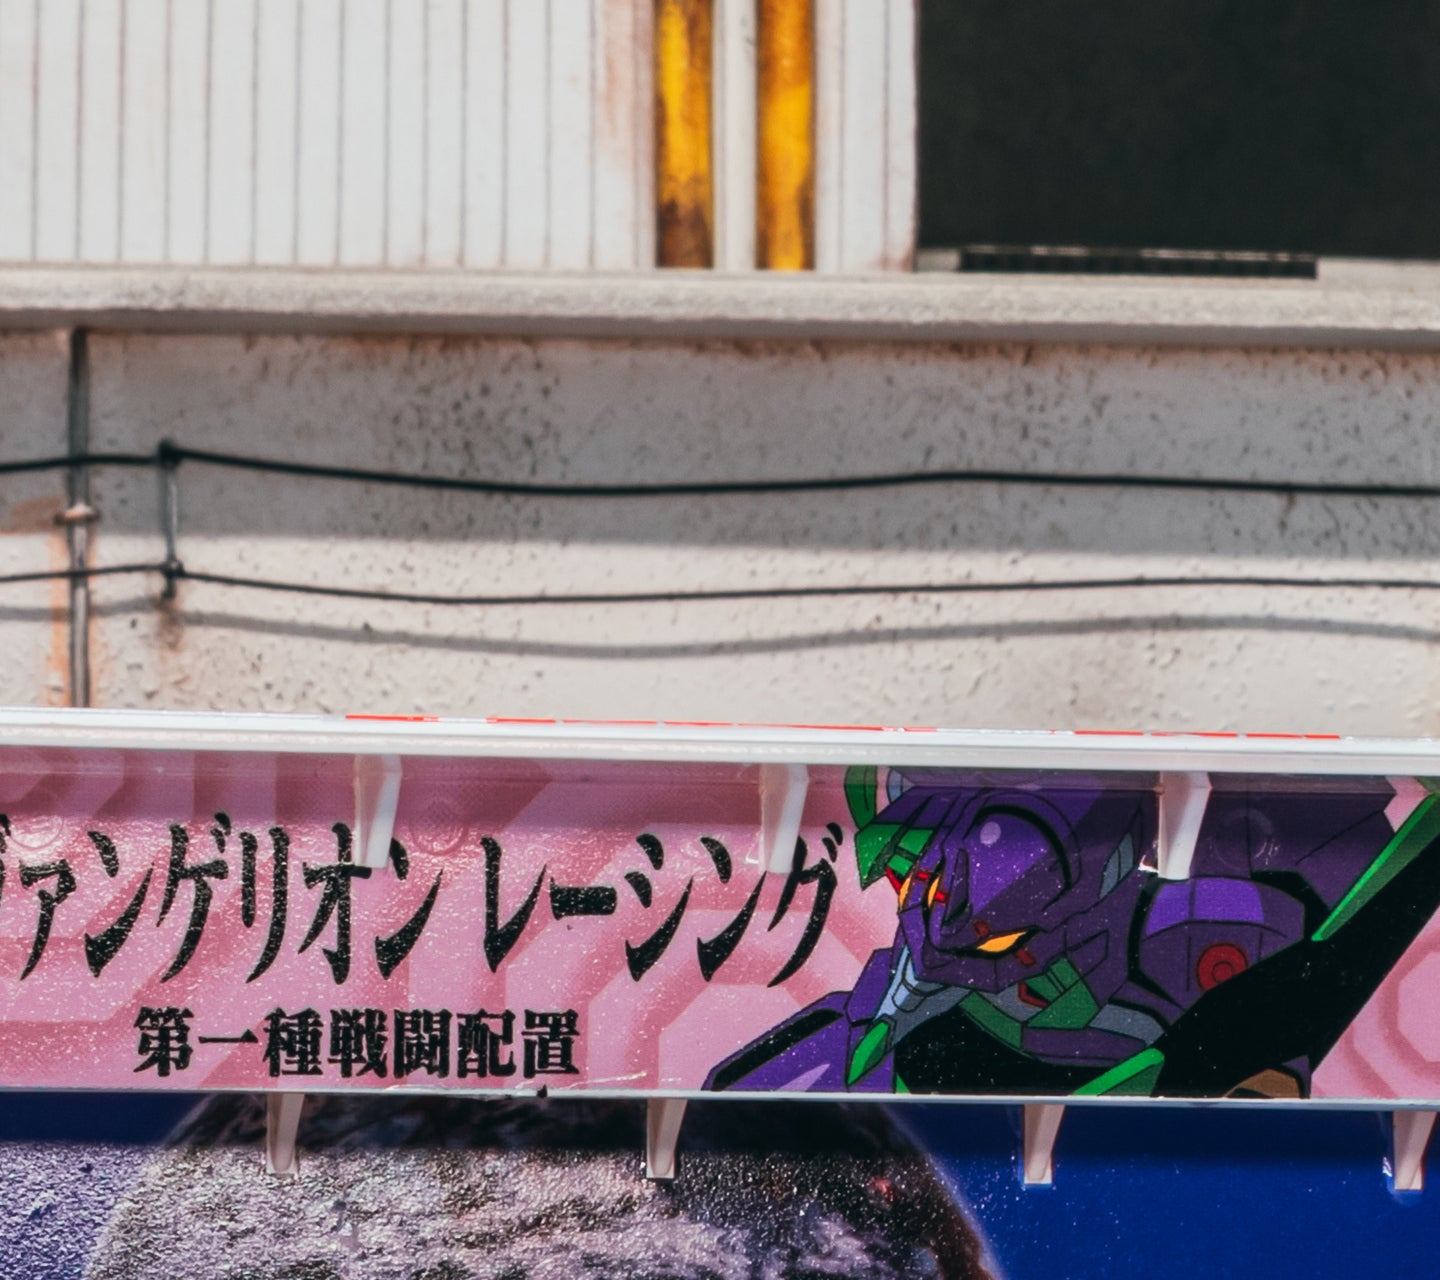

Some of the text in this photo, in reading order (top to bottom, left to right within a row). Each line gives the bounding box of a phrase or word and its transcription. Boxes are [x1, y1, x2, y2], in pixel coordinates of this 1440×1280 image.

[480, 822, 844, 989] レーシング
[132, 1005, 581, 1079] 第一種戦闘配置
